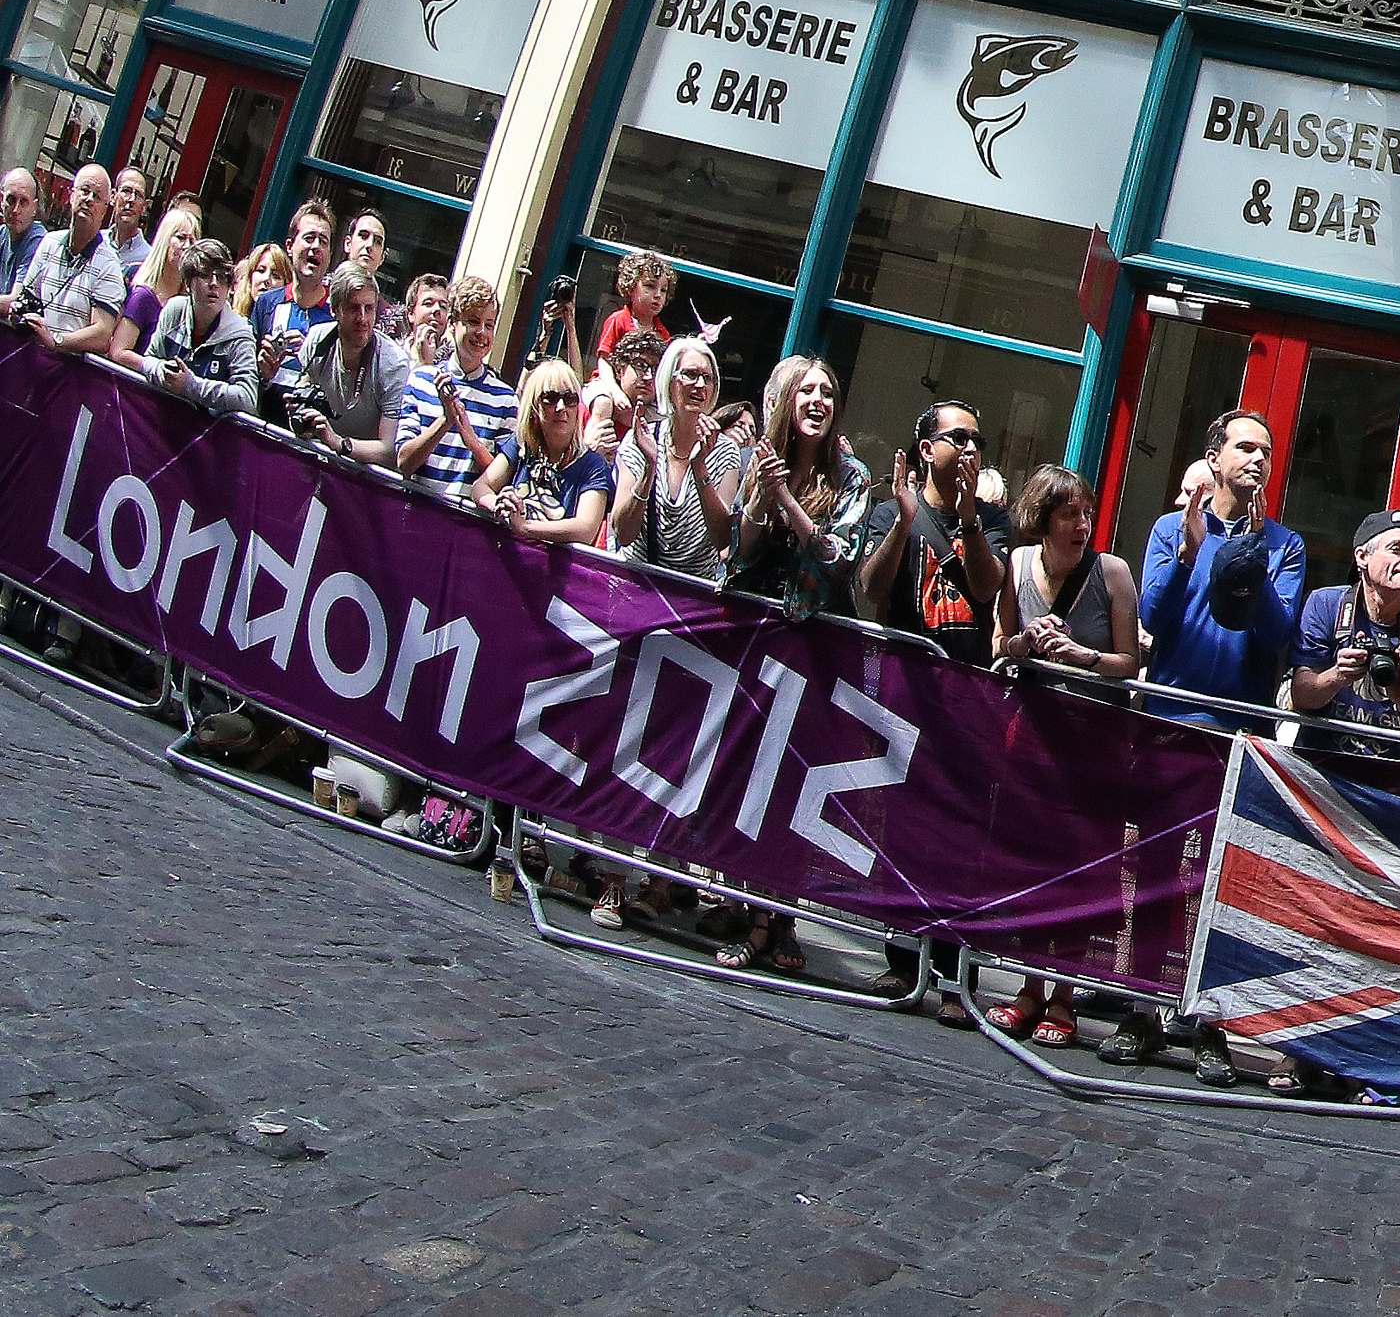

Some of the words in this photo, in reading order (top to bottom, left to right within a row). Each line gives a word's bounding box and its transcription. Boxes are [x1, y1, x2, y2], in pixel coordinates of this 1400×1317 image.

[675, 62, 701, 105] &
[709, 69, 788, 125] BAR
[1242, 178, 1272, 226] &
[1287, 188, 1383, 248] BAR
[48, 404, 480, 745] London
[515, 594, 920, 879] 2012
